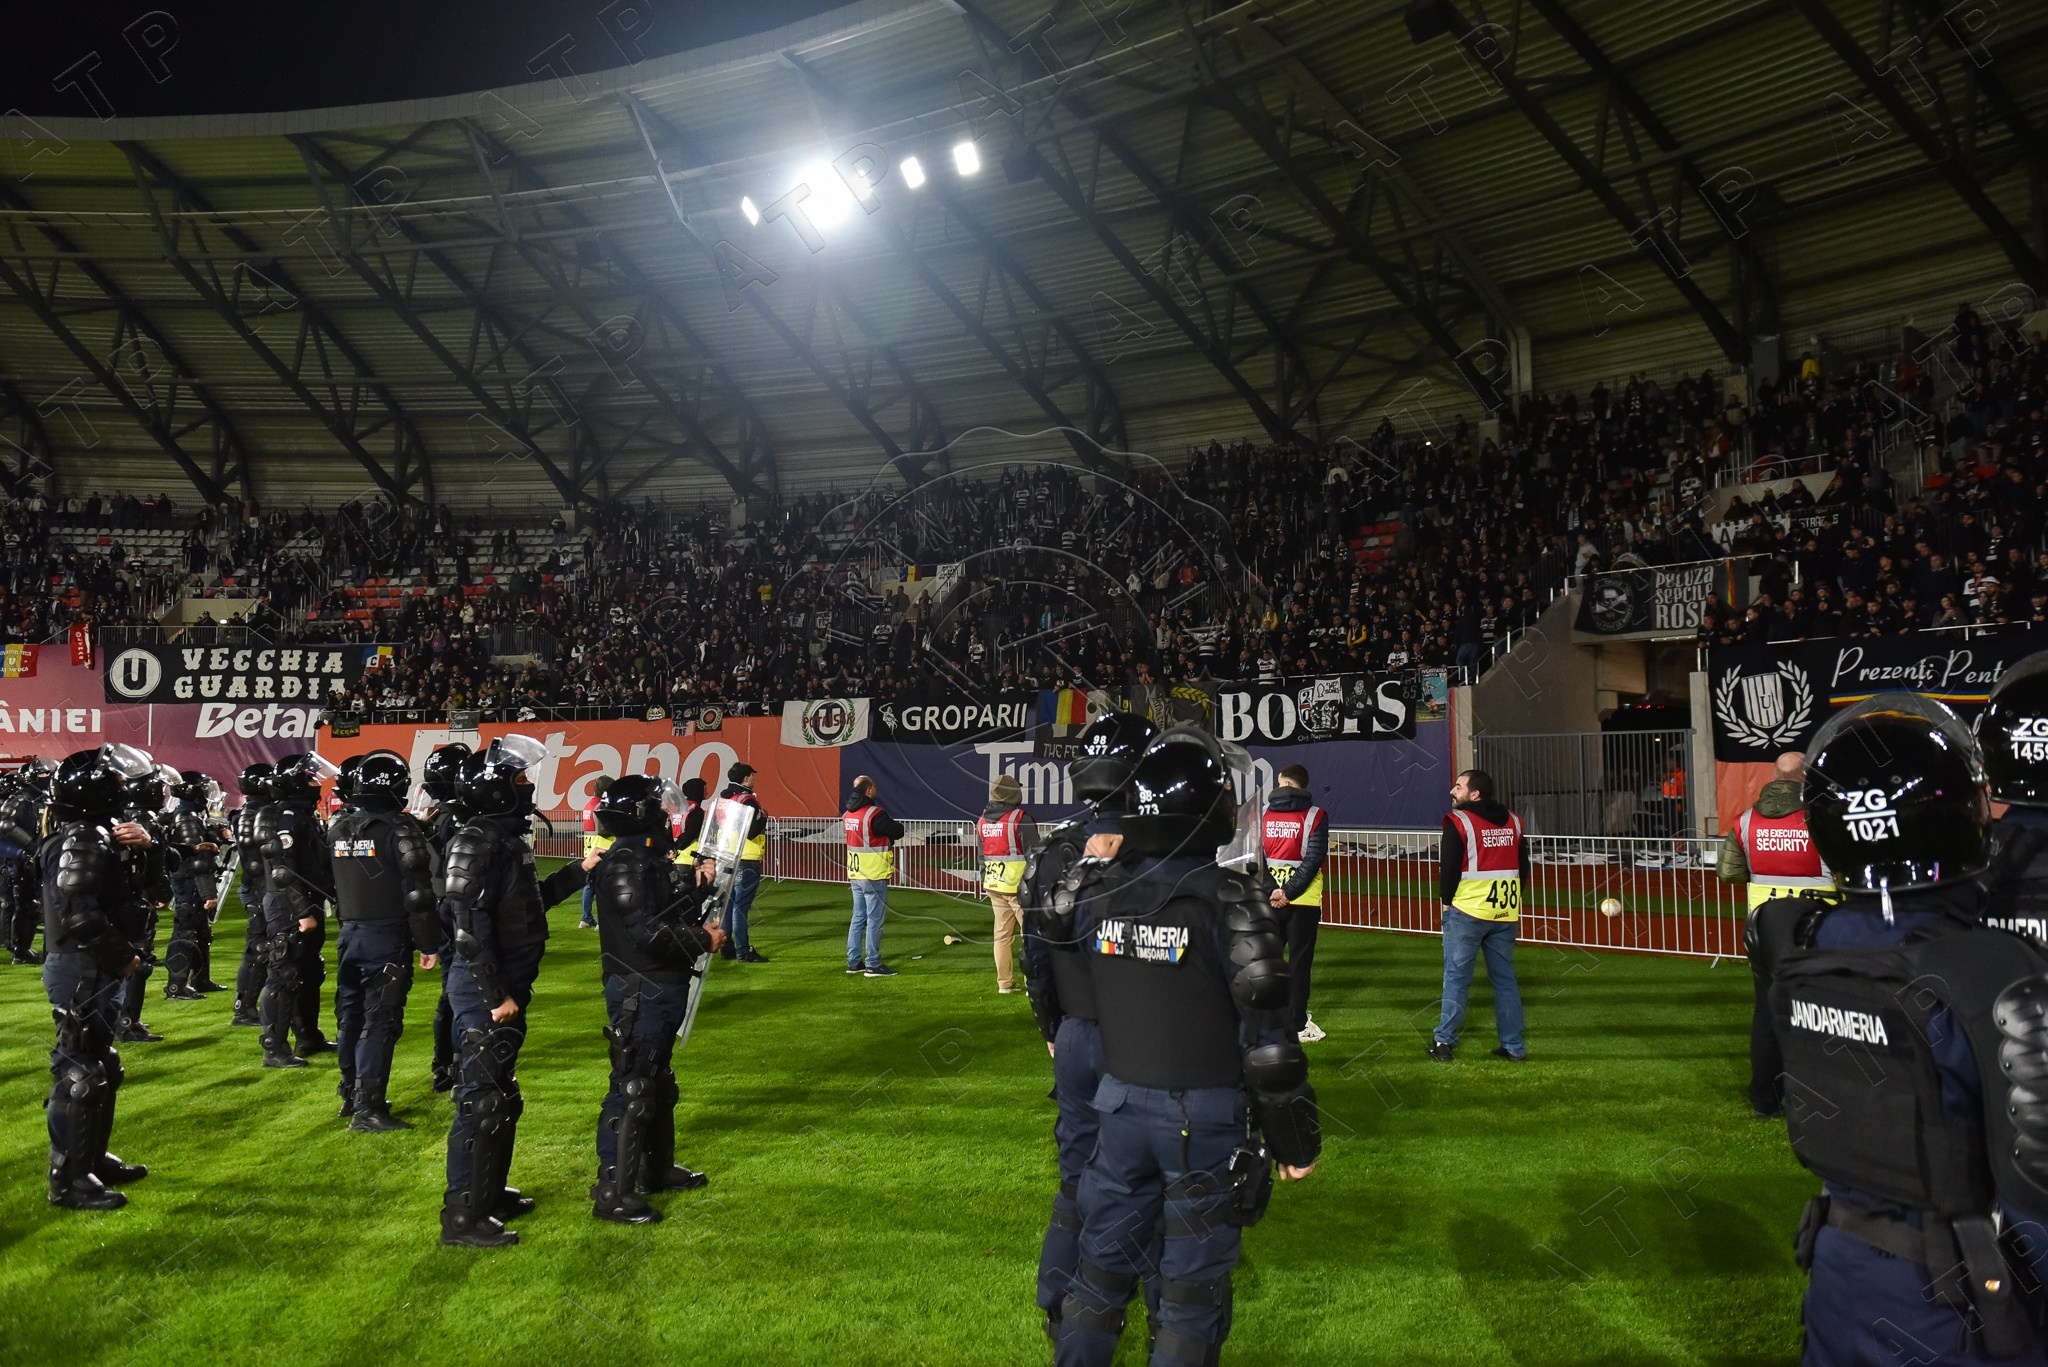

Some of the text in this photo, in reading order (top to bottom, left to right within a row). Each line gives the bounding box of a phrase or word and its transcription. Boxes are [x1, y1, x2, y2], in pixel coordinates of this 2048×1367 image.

[181, 647, 343, 673] VECCHIA
[1941, 649, 2008, 688] Pent
[901, 702, 1028, 731] GROPARII
[1093, 735, 1107, 744] 98
[1139, 790, 1153, 803] 98
[1847, 788, 1888, 813] ZG
[1266, 828, 1299, 838] SECURITY
[1483, 836, 1514, 847] SECURITY
[1756, 829, 1809, 838] SVS EXECUTION
[1847, 816, 1900, 842] 1021
[1756, 838, 1809, 852] SECURITY
[1486, 880, 1518, 909] 438
[1097, 919, 1189, 947] JANARMERIA
[1790, 998, 1889, 1046] JANDARMERIA
